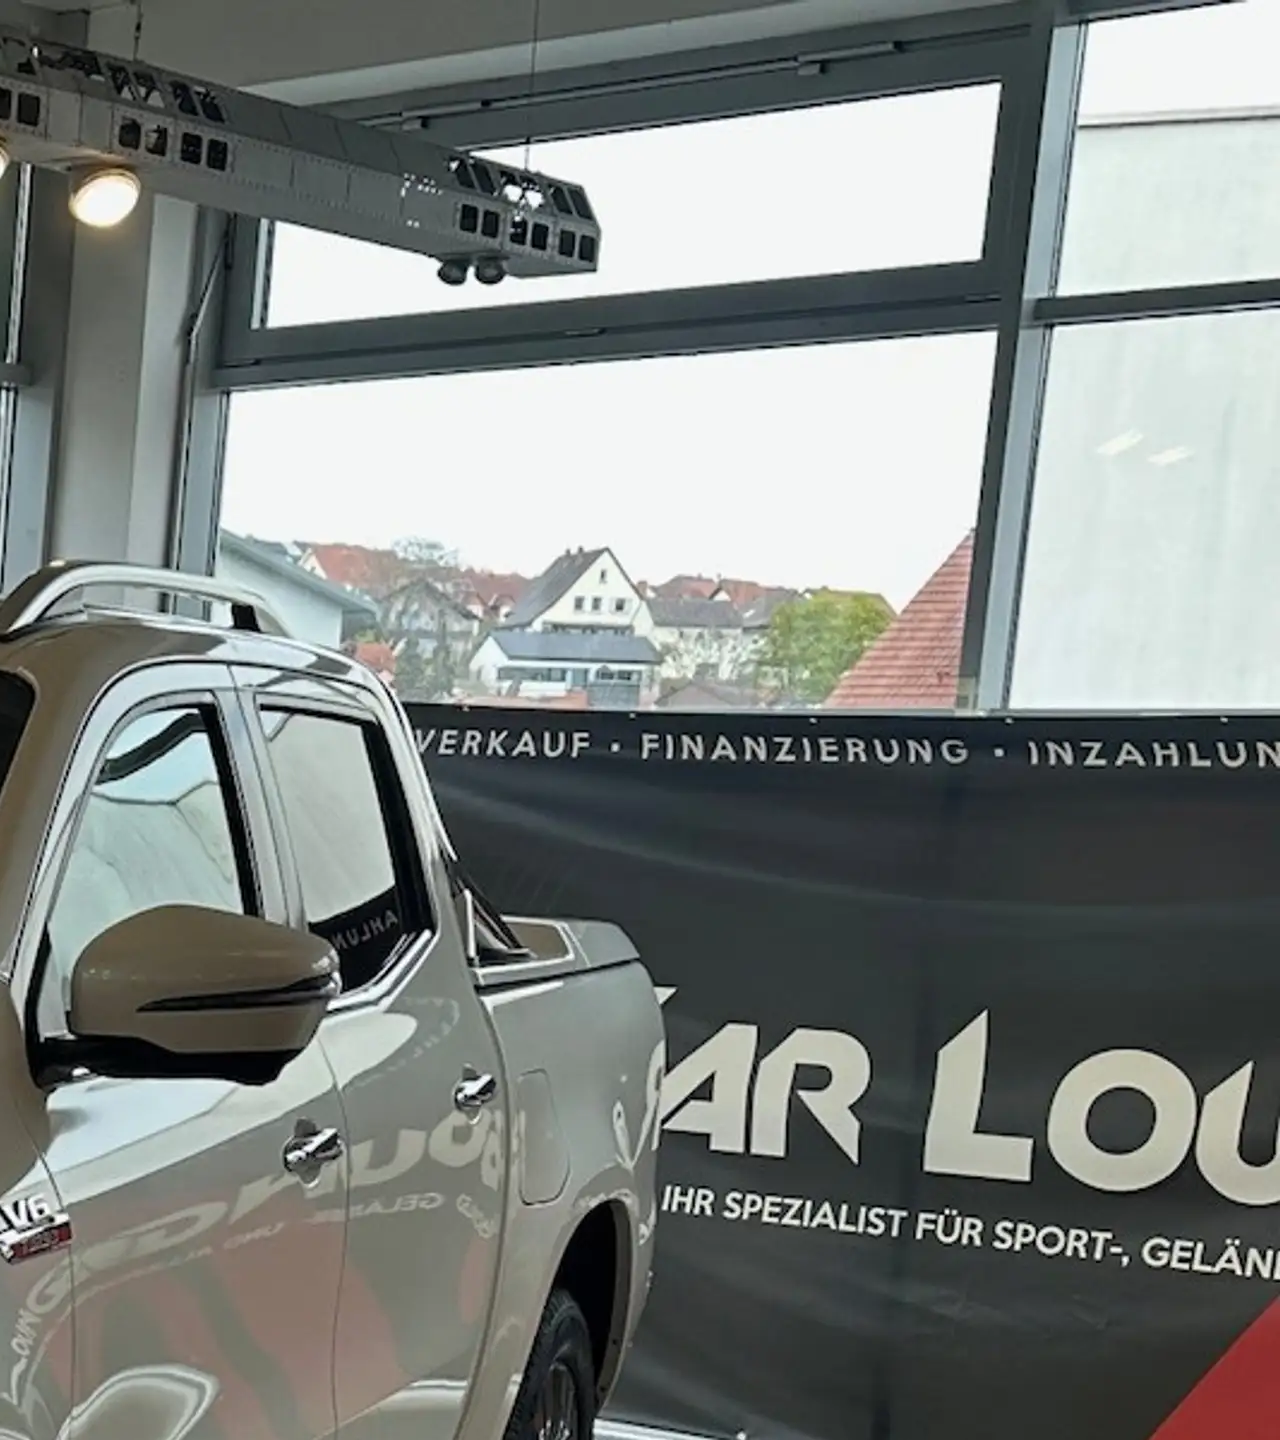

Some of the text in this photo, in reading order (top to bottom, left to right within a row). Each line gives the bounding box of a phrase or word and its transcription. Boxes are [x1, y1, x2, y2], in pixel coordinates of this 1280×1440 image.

[414, 728, 590, 758] VERKAUF
[641, 732, 970, 765] FINANZIERUNG
[652, 987, 871, 1165] AR
[661, 1184, 1280, 1281] IHR SPEZIALIST FÜR SPORT-, GELÄN
